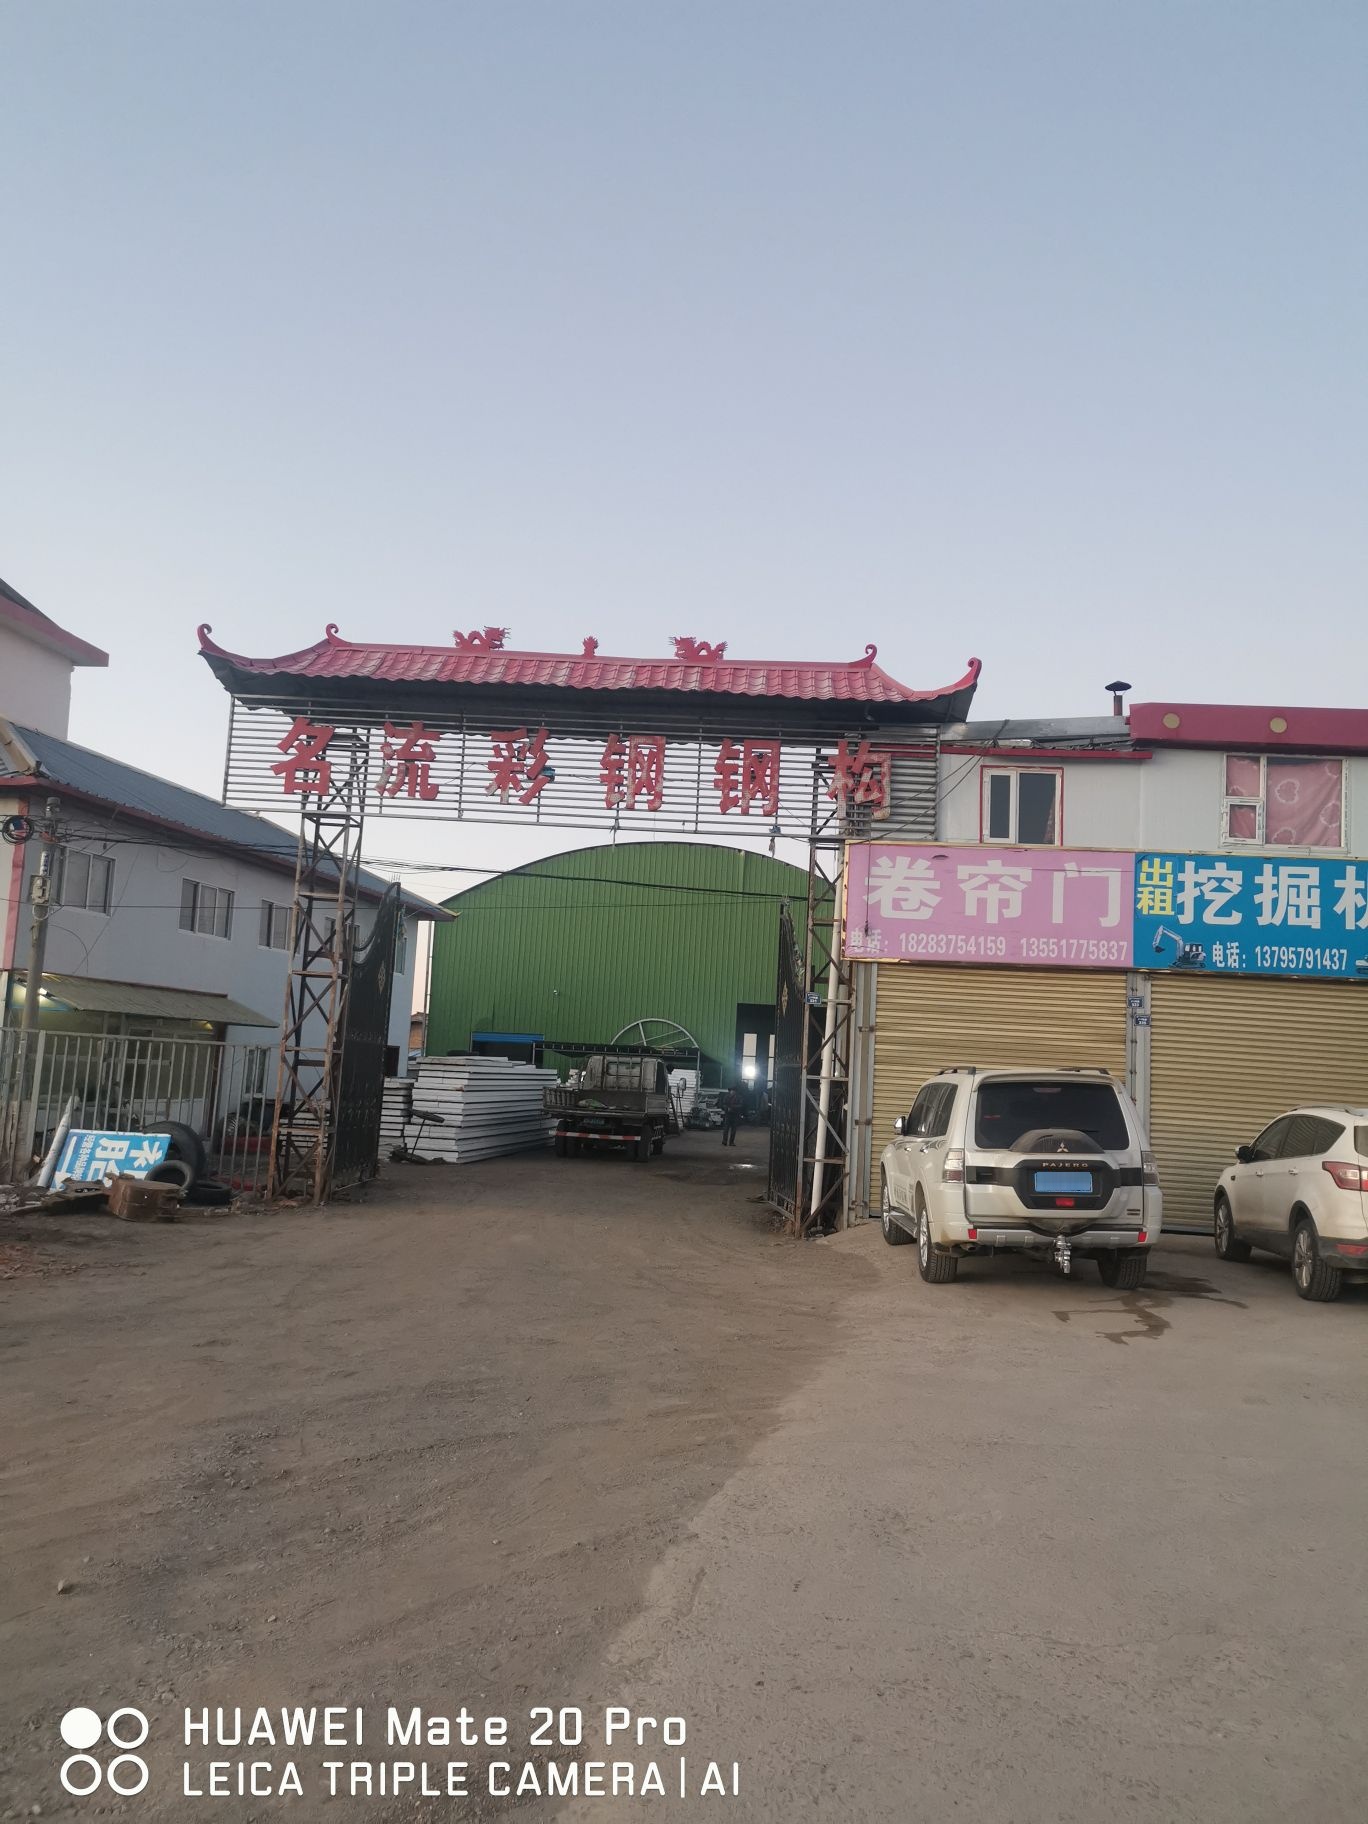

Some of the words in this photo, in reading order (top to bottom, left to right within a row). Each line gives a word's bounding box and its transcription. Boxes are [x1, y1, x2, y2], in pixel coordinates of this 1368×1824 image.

[271, 717, 892, 821] 名流彩钢钢构
[863, 856, 1121, 927] 卷帘门
[1137, 858, 1174, 916] 出租
[900, 933, 1006, 956] 18283754159
[1020, 937, 1128, 961] 13551775837
[1255, 946, 1347, 970] 13795791437
